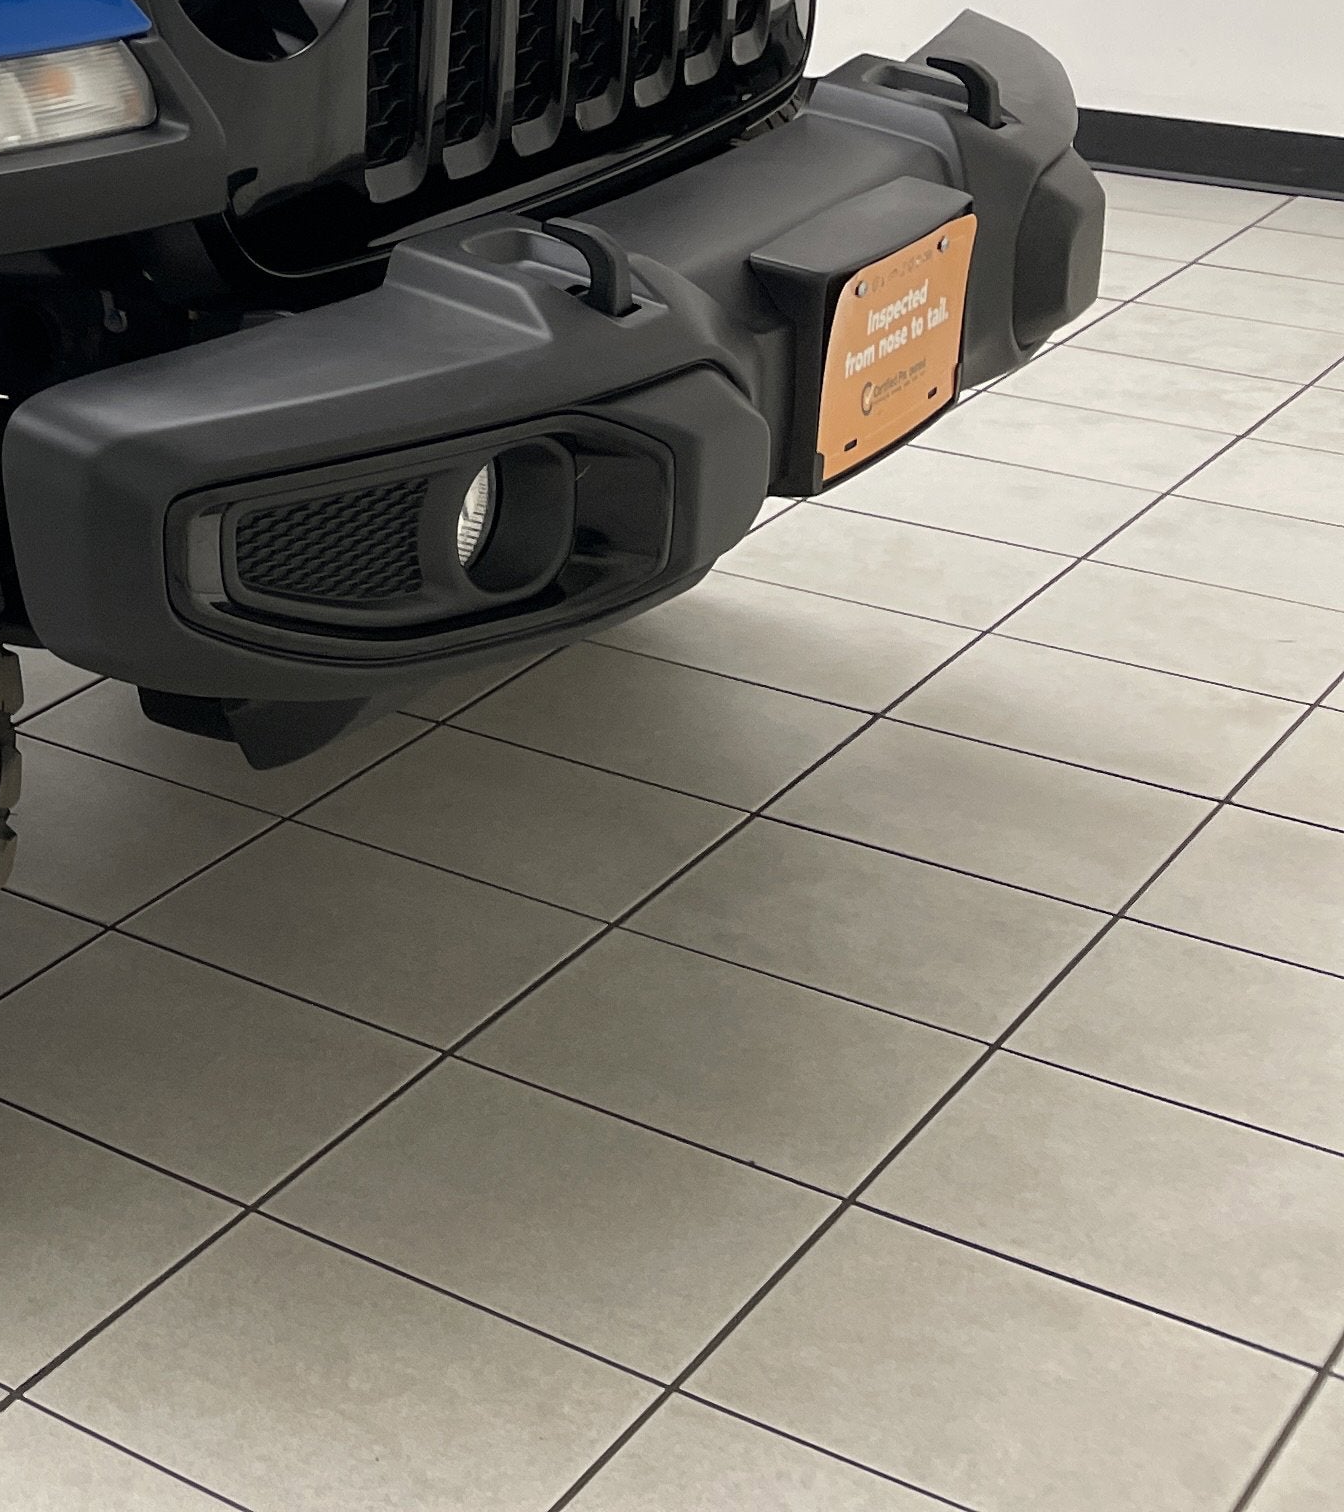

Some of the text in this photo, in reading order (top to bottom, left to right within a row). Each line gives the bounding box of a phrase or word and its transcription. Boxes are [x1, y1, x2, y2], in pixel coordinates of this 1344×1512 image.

[844, 295, 950, 379] from nose to tail.
[867, 278, 929, 336] Inspected
